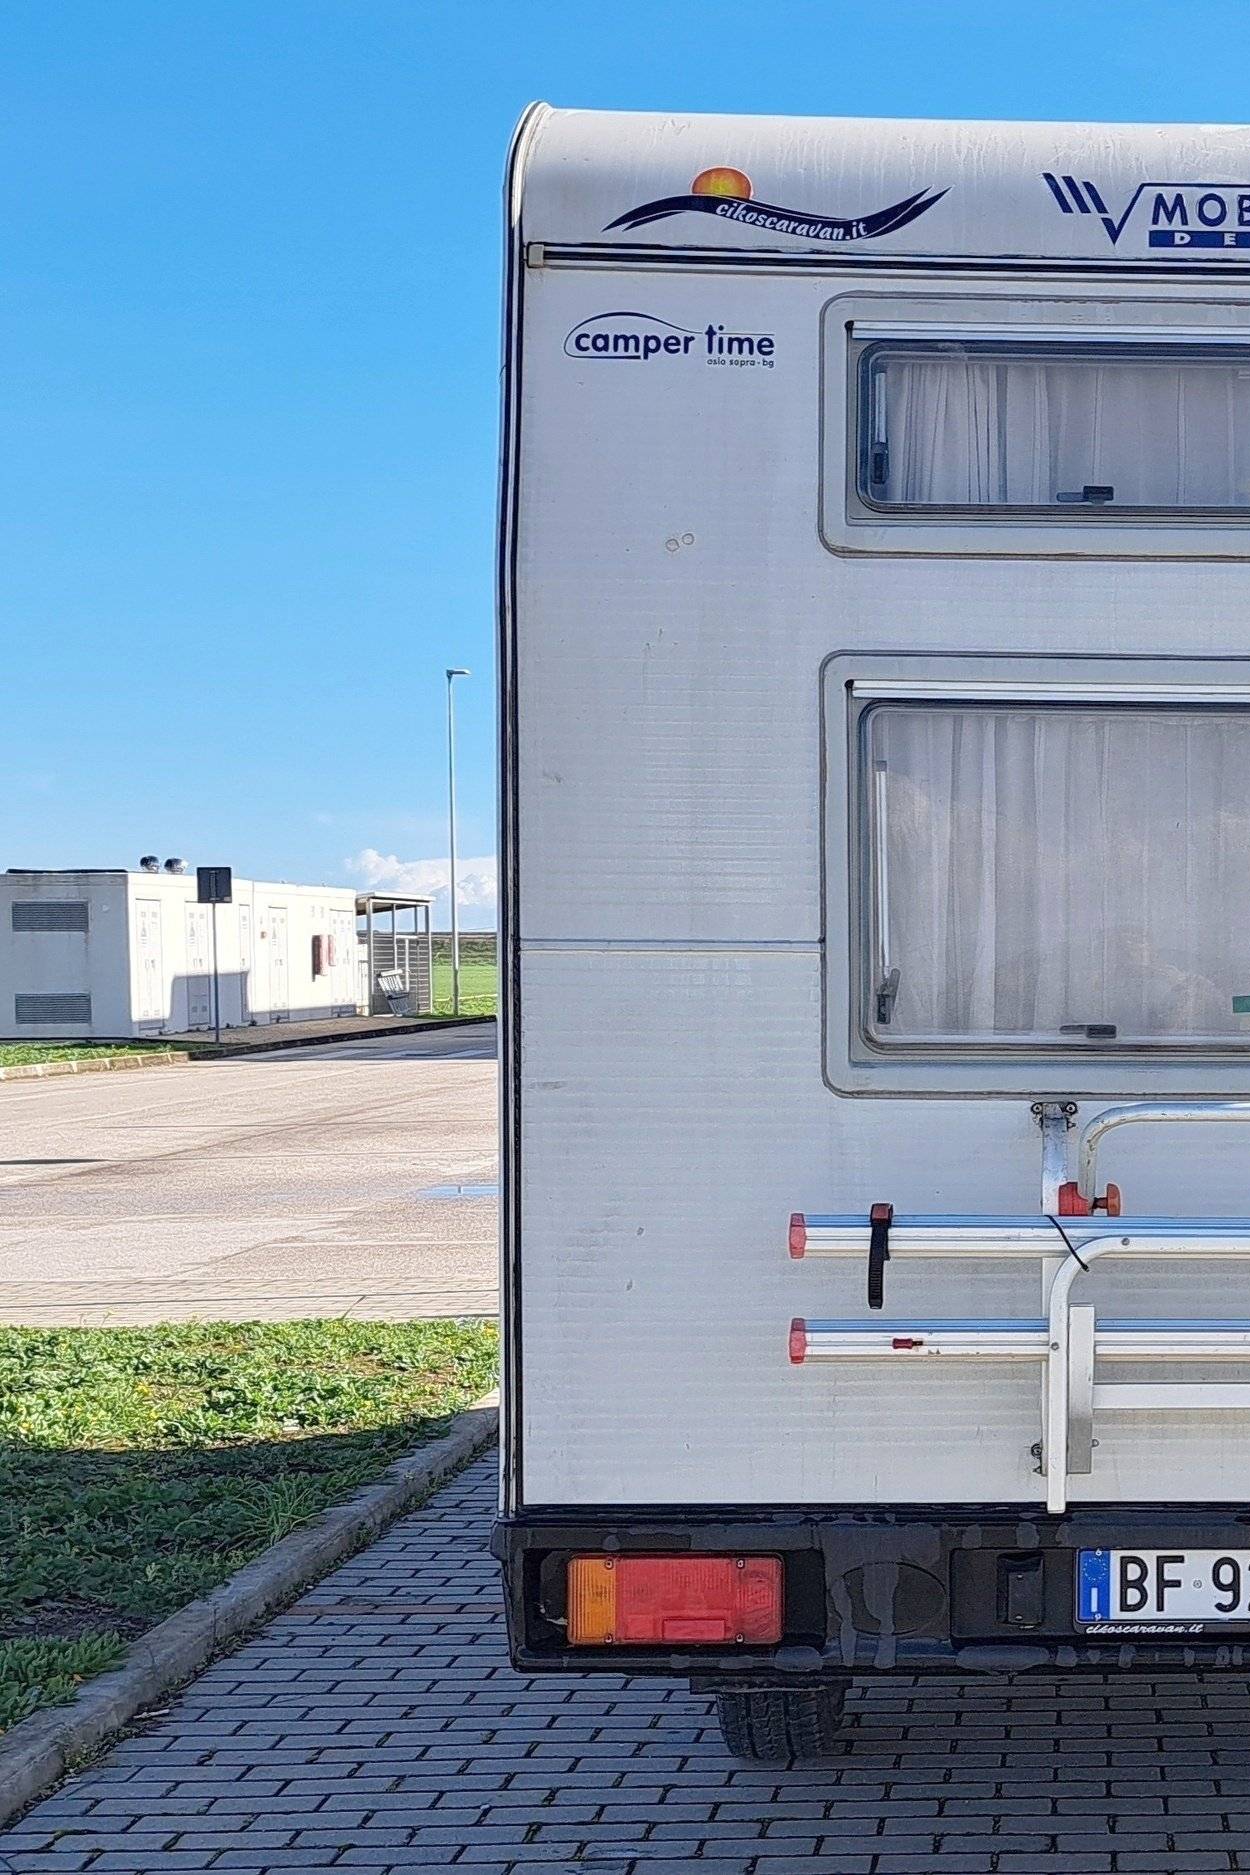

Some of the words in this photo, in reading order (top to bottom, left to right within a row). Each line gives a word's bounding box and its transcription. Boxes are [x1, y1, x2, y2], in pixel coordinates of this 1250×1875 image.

[715, 202, 868, 241] cikoscaravan.it
[574, 333, 695, 360] camper
[705, 324, 775, 356] time
[1118, 1555, 1186, 1613] BF
